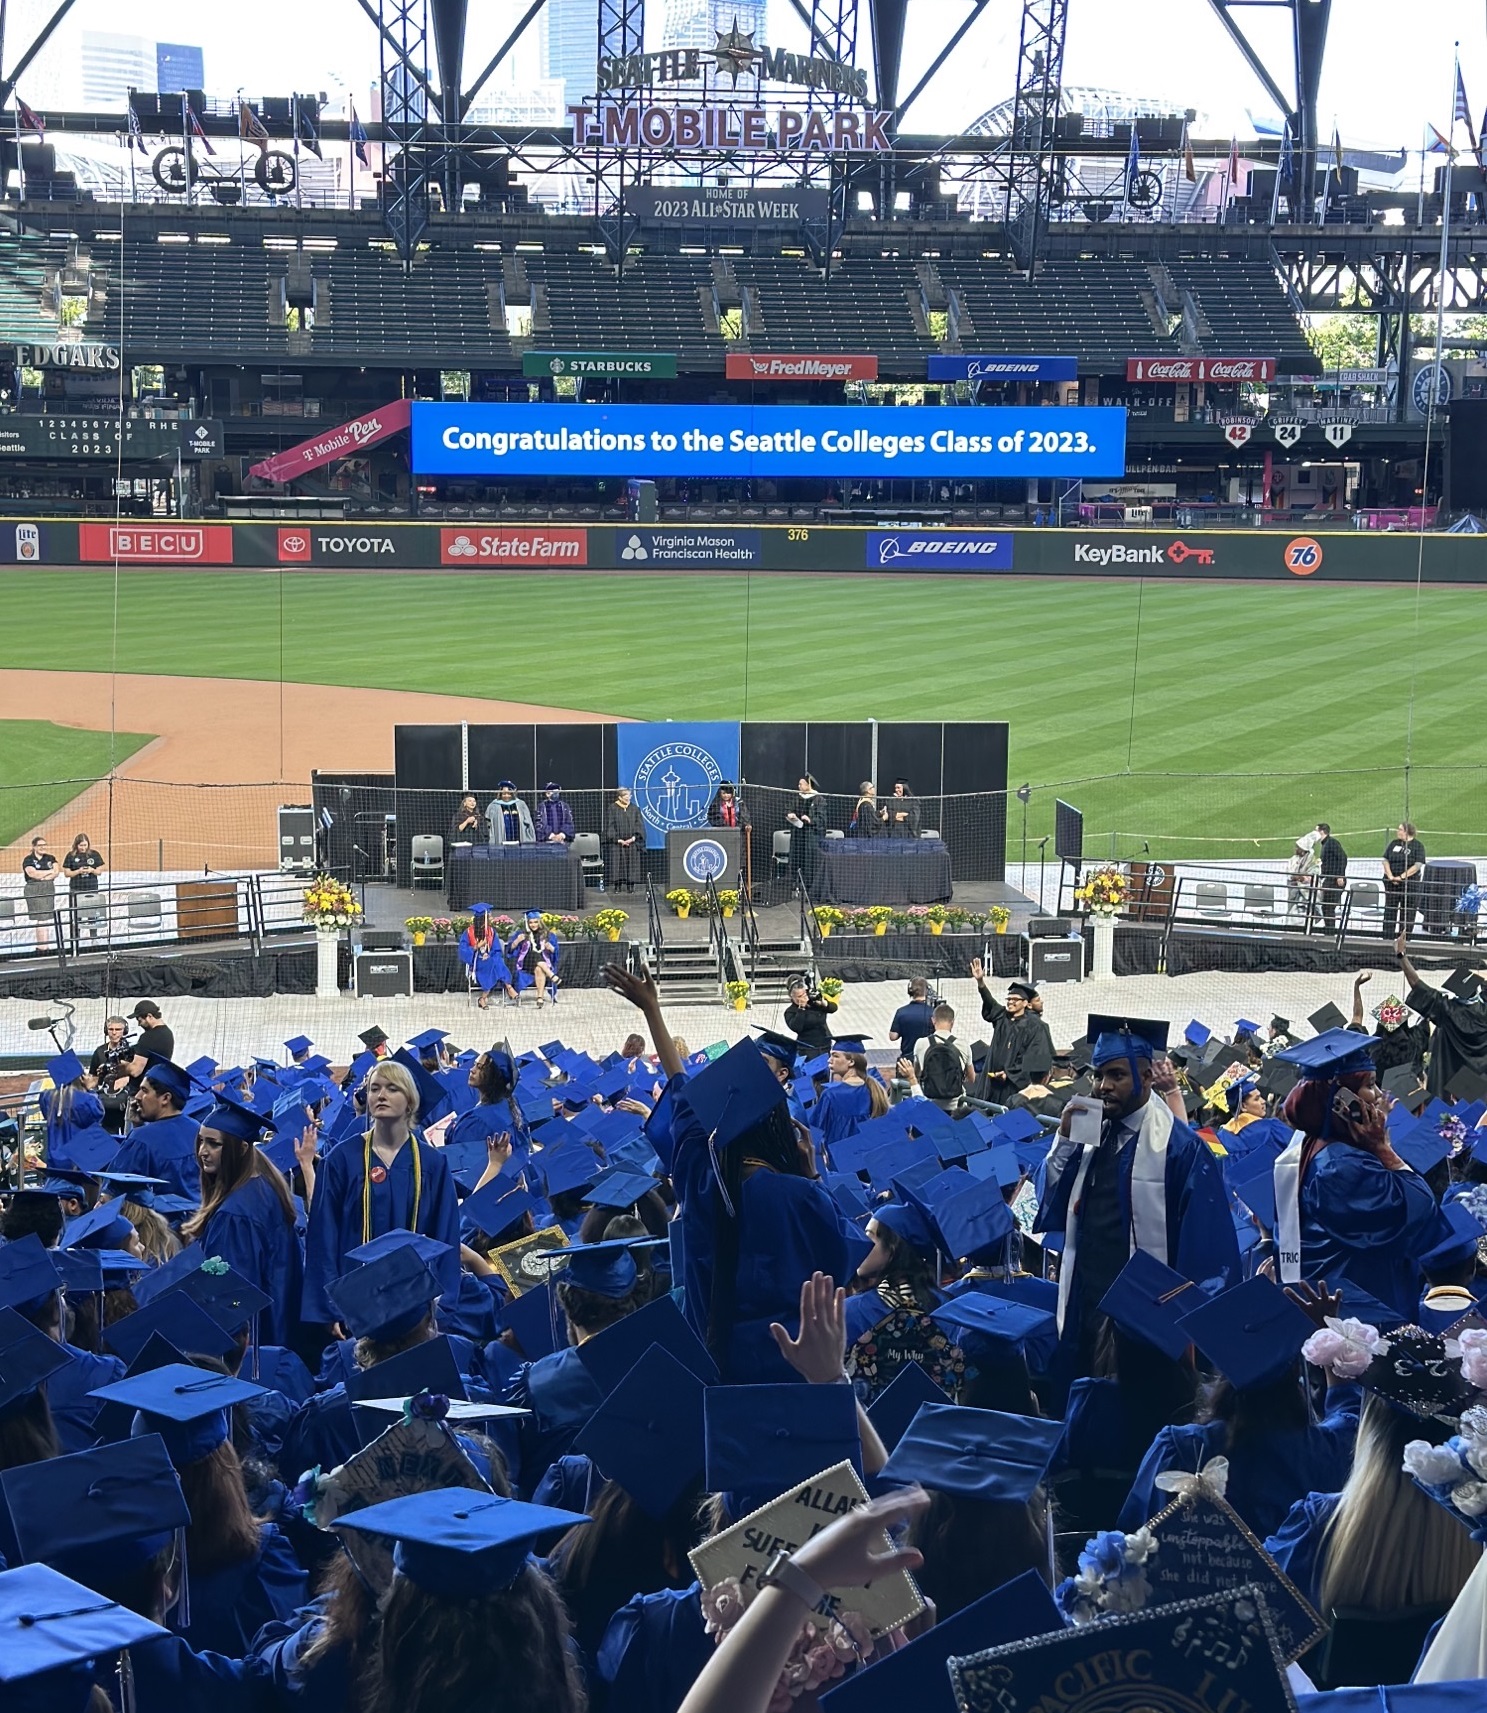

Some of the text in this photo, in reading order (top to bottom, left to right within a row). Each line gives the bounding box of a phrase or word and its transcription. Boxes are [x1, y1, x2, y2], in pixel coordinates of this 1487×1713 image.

[596, 45, 869, 98] SEATTLE MARINERS
[566, 105, 895, 151] T-MOBILE PARK
[705, 188, 750, 200] HOME OF
[654, 200, 689, 218] 2023
[759, 201, 800, 219] WEEK
[15, 344, 121, 370] EDGARS
[570, 360, 653, 373] STARBUCKS
[984, 363, 1040, 373] BOEING
[1339, 372, 1357, 382] CRAB
[1357, 372, 1379, 382] SHACK
[1221, 416, 1256, 426] ROBINSON
[1272, 416, 1304, 425] GRIFFEY
[1320, 416, 1357, 426] MARTINEZ
[314, 434, 351, 458] Mobile
[345, 417, 383, 445] Pen
[1228, 426, 1247, 440] 42
[1279, 426, 1297, 440] 24
[1332, 426, 1345, 440] 11
[0, 444, 26, 453] eattle
[71, 445, 112, 454] 2023
[442, 426, 1097, 459] Congratulations to the Seattle Colleges Class of 2023.
[194, 446, 211, 454] PARK
[1126, 464, 1159, 474] ULLPEN
[18, 528, 37, 541] Lite
[787, 528, 809, 541] 376
[317, 537, 396, 554] TOYOTA
[652, 536, 735, 549] Virginia Mason
[907, 541, 998, 555] BOEING
[652, 548, 754, 560] Franciscan Health
[1074, 544, 1164, 565] KeyBank
[1290, 546, 1318, 567] 76
[638, 745, 720, 781] SEATTLE COLLEGES
[642, 805, 660, 825] North
[887, 1348, 924, 1362] My Why
[1203, 1514, 1226, 1526] was
[1183, 1553, 1253, 1569] not because
[1186, 1568, 1210, 1585] did
[1215, 1573, 1238, 1588] not
